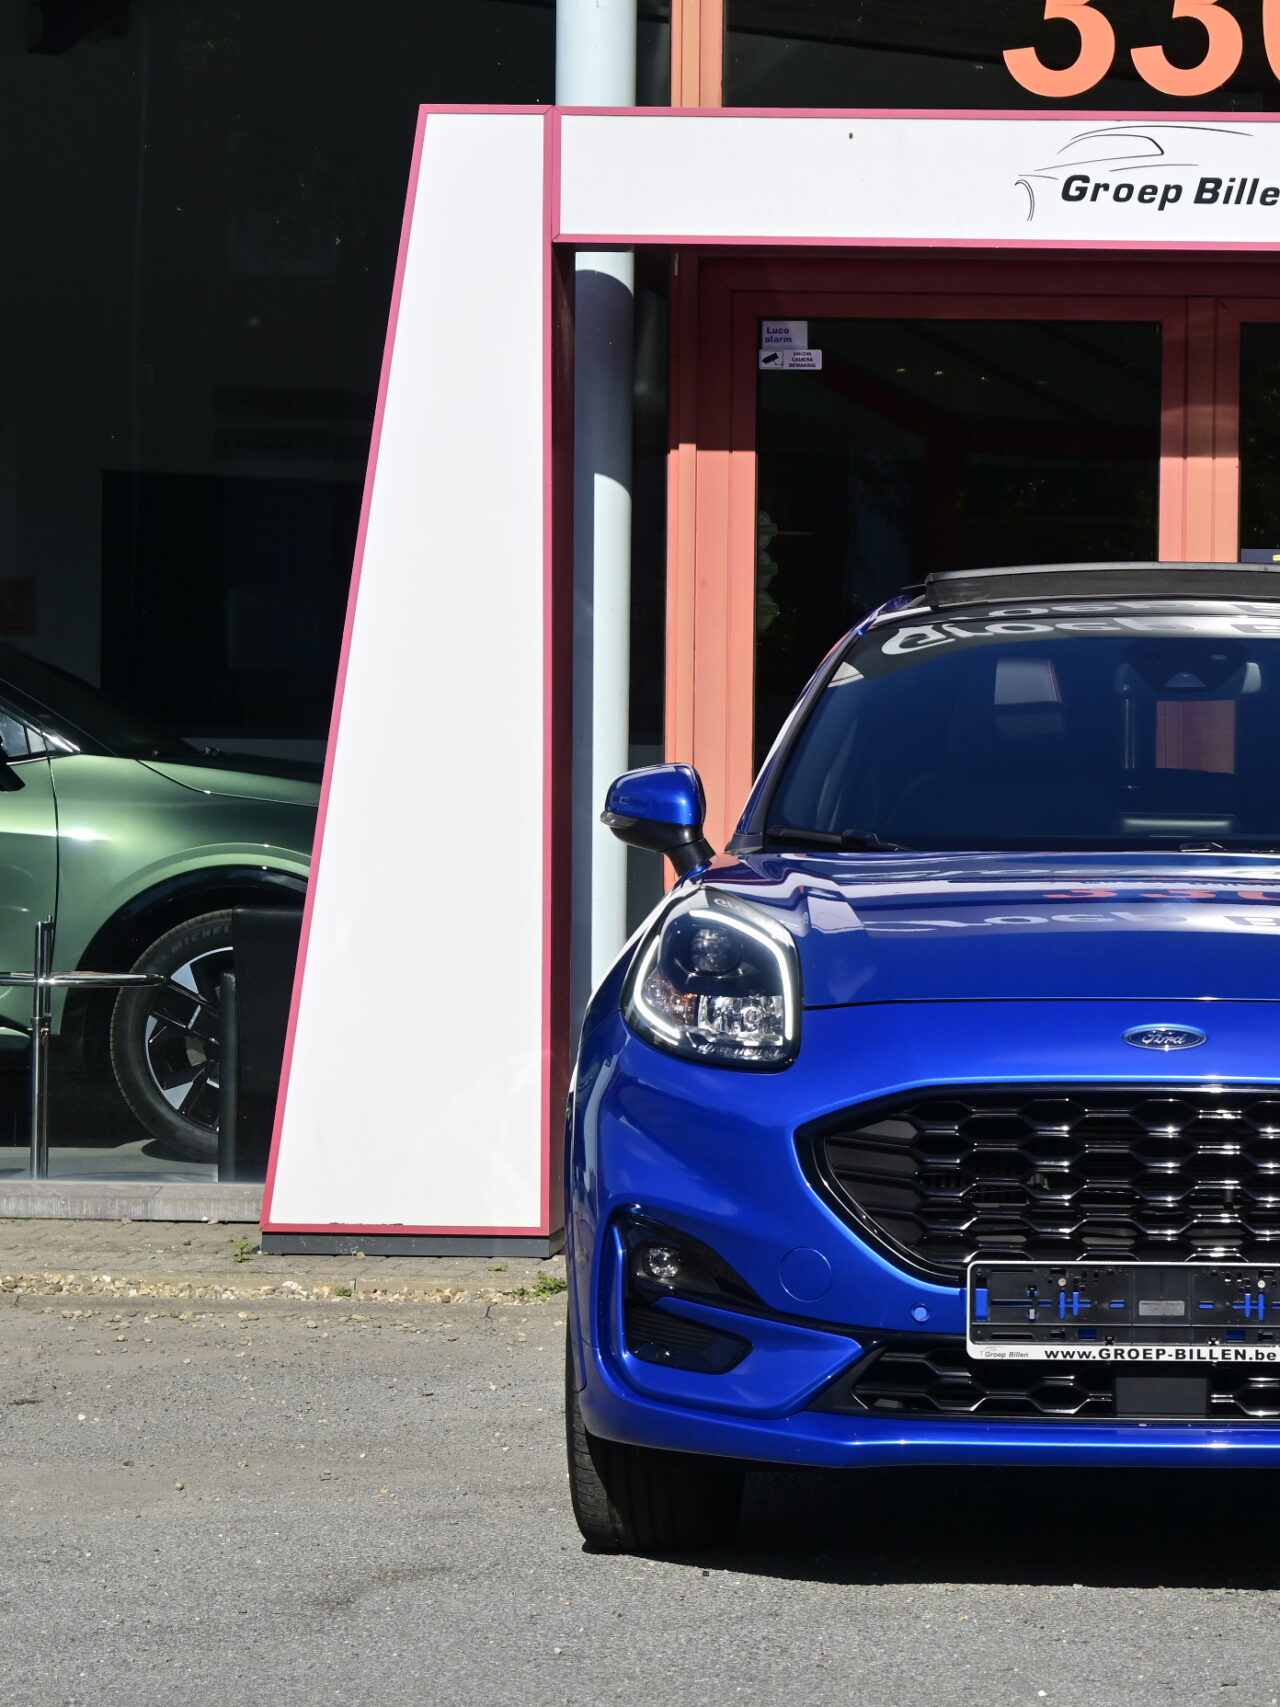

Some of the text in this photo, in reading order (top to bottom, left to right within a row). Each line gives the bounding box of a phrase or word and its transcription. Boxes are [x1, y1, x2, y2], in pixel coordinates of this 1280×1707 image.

[1061, 174, 1183, 211] Groep
[764, 335, 792, 343] alarm
[1141, 1030, 1187, 1044] Ford
[984, 1351, 1006, 1359] Groep
[1044, 1347, 1277, 1361] www.GROEP-BILLEN.be
